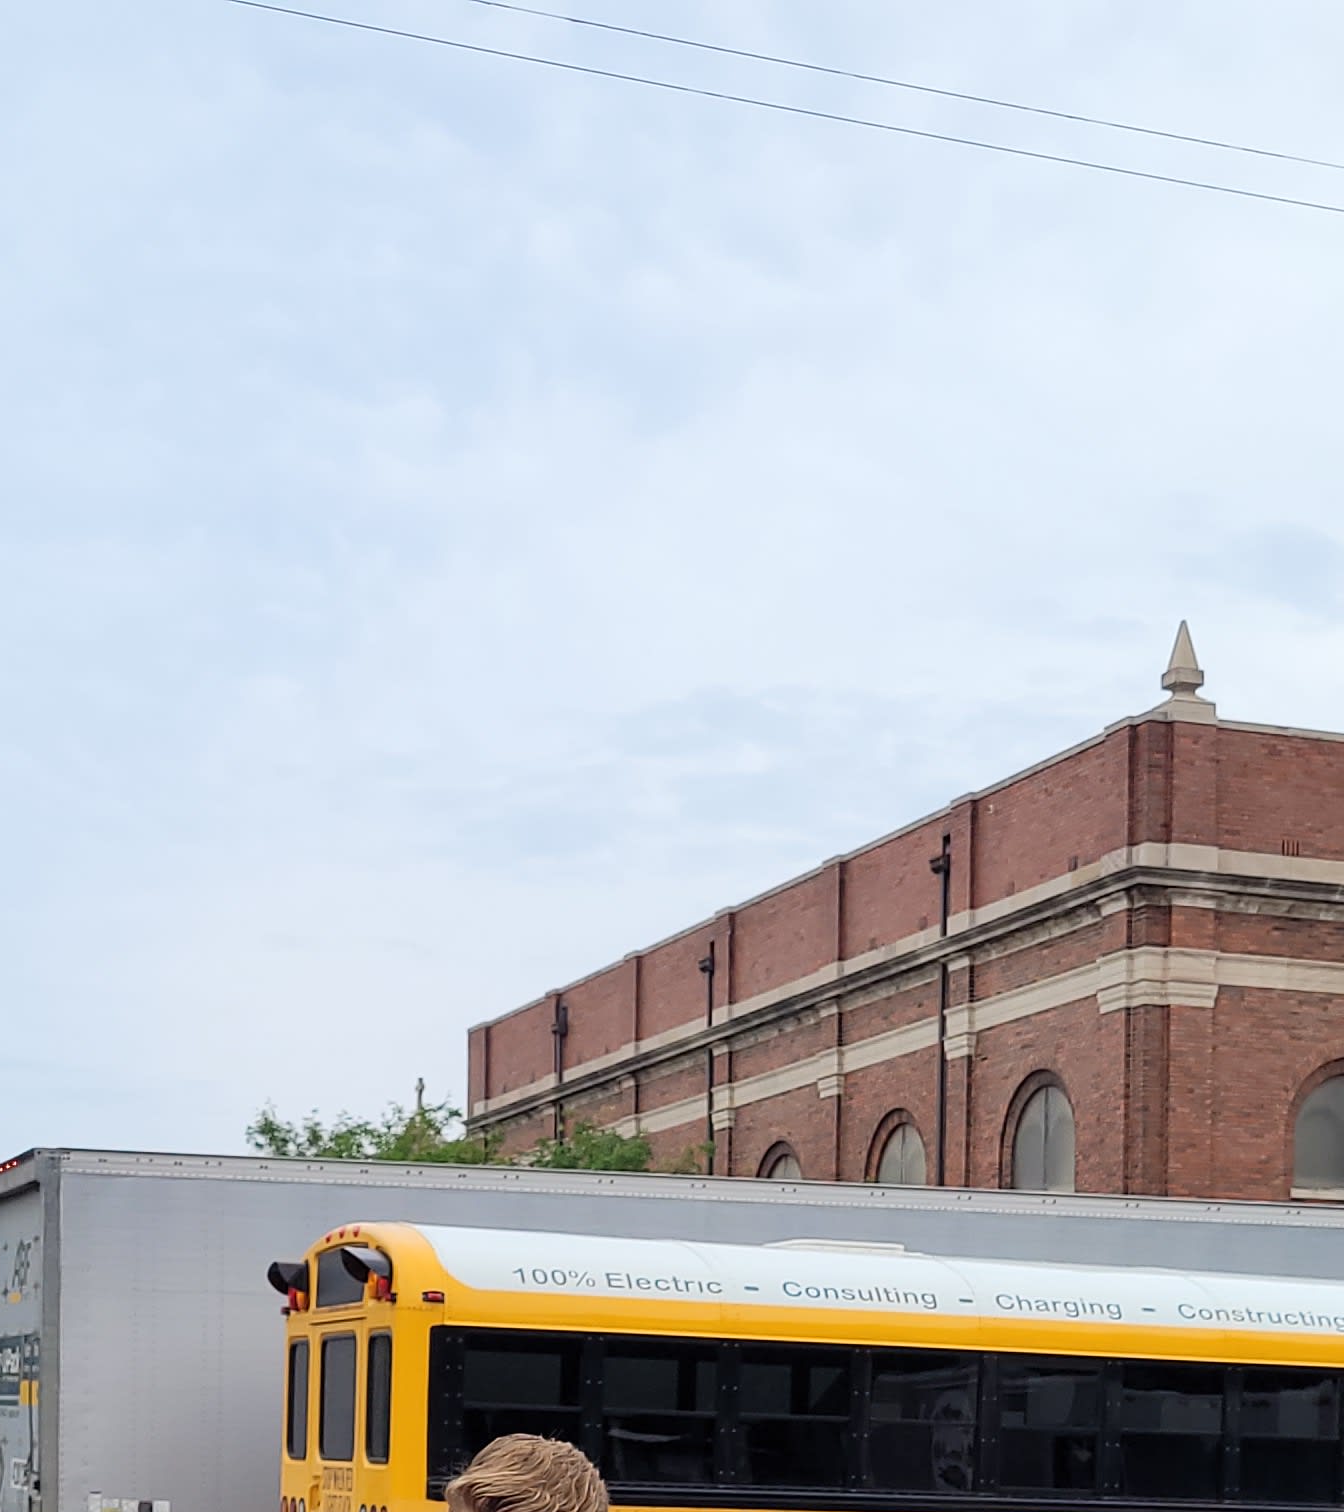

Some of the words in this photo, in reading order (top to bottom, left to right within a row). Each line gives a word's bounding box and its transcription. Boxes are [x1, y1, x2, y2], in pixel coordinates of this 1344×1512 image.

[512, 1267, 596, 1288] 100%
[605, 1272, 723, 1295] Electric
[782, 1281, 938, 1310] Consulting
[995, 1293, 1122, 1321] Charging
